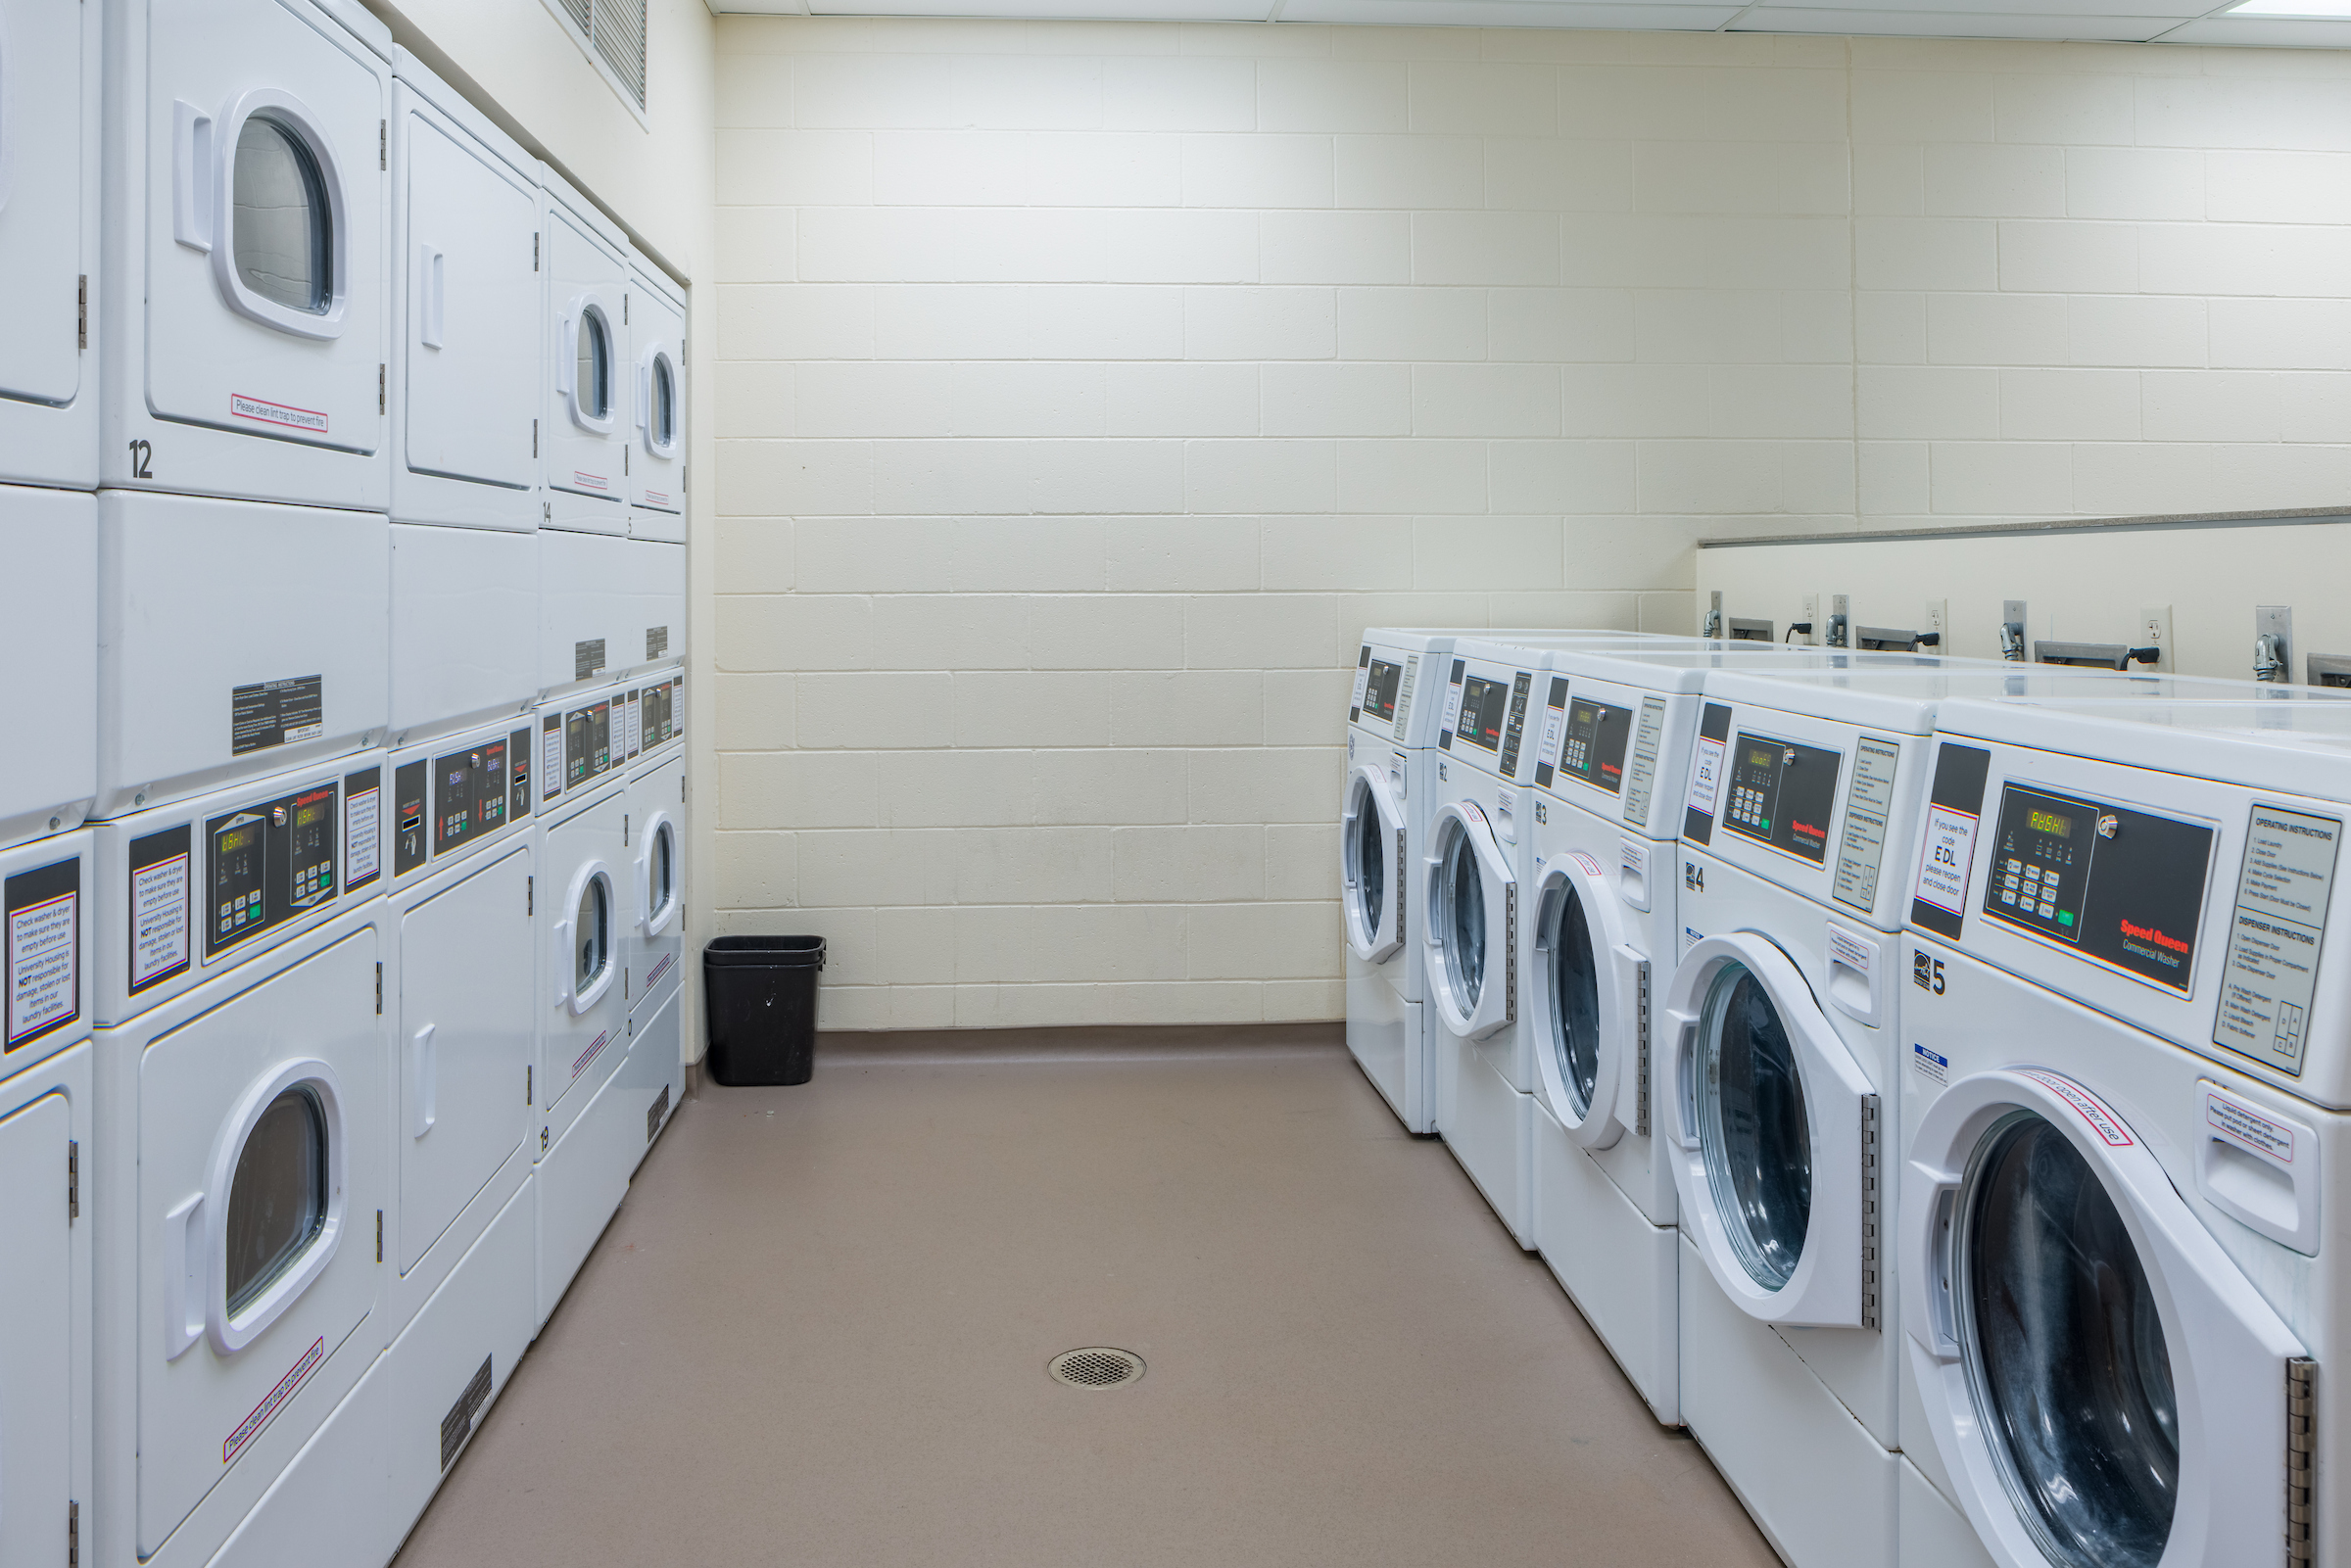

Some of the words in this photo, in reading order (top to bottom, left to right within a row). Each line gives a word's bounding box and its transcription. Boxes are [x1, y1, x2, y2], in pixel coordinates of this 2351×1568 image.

[237, 399, 254, 413] Please
[256, 405, 269, 416] clean
[279, 411, 289, 422] trap
[291, 413, 296, 421] to
[297, 415, 315, 425] prevent
[129, 439, 152, 479] 12
[543, 501, 551, 523] 14
[1542, 804, 1546, 825] 3
[1792, 820, 1809, 833] Speed
[1808, 825, 1825, 838] Queen
[1949, 825, 1958, 833] see
[1959, 826, 1967, 836] the
[2256, 818, 2288, 831] OPERATING
[2289, 825, 2332, 841] INSTRUCTIONS
[1793, 833, 1810, 845] Commercial
[1809, 839, 1820, 849] Washer
[1942, 836, 1955, 846] code
[139, 876, 153, 886] Check
[154, 871, 168, 880] washer
[172, 865, 183, 874] dryer
[1696, 867, 1704, 893] 4
[1926, 864, 1942, 876] please
[1943, 870, 1960, 882] reopen
[145, 886, 156, 895] make
[1923, 877, 1933, 886] and
[1933, 880, 1946, 891] close
[1947, 885, 1959, 895] door
[143, 897, 157, 907] empty
[158, 892, 172, 901] before
[17, 917, 33, 929] Check
[35, 912, 52, 923] washer
[58, 906, 70, 916] dryer
[140, 914, 161, 927] University
[163, 907, 178, 917] Housing
[24, 929, 38, 939] make
[39, 926, 50, 934] sure
[51, 921, 61, 930] they
[141, 927, 151, 938] NOT
[153, 919, 175, 933] responsible
[2121, 919, 2153, 941] Speed
[2154, 930, 2188, 954] Queen
[2239, 916, 2270, 931] DISPENSER
[2271, 926, 2314, 945] INSTRUCTIONS
[22, 942, 38, 952] empty
[40, 935, 56, 946] before
[2123, 939, 2156, 960] Commercial
[2158, 951, 2180, 967] Washer
[18, 960, 44, 975] University
[45, 952, 65, 964] Housing
[19, 975, 32, 987] NOT
[32, 965, 61, 982] responsible
[40, 981, 55, 992] stolen
[62, 973, 70, 982] lost
[1933, 959, 1945, 996] 5
[30, 998, 43, 1008] items
[23, 1011, 42, 1023] laundry
[1923, 1049, 1939, 1062] NOTICE
[2056, 1083, 2081, 1102] open
[2077, 1102, 2104, 1122] after
[2099, 1121, 2119, 1140] use
[2223, 1104, 2237, 1114] Liquid
[2237, 1111, 2261, 1126] detergent
[2210, 1106, 2223, 1117] Please
[2249, 1126, 2262, 1136] sheet
[2263, 1133, 2289, 1148] detergent
[2226, 1125, 2242, 1134] washer
[541, 1126, 549, 1152] 19
[230, 1426, 248, 1450] Please
[249, 1409, 264, 1429] clean
[264, 1398, 273, 1412] lint
[273, 1386, 284, 1405] trap
[285, 1379, 290, 1389] to
[292, 1356, 310, 1387] prevent
